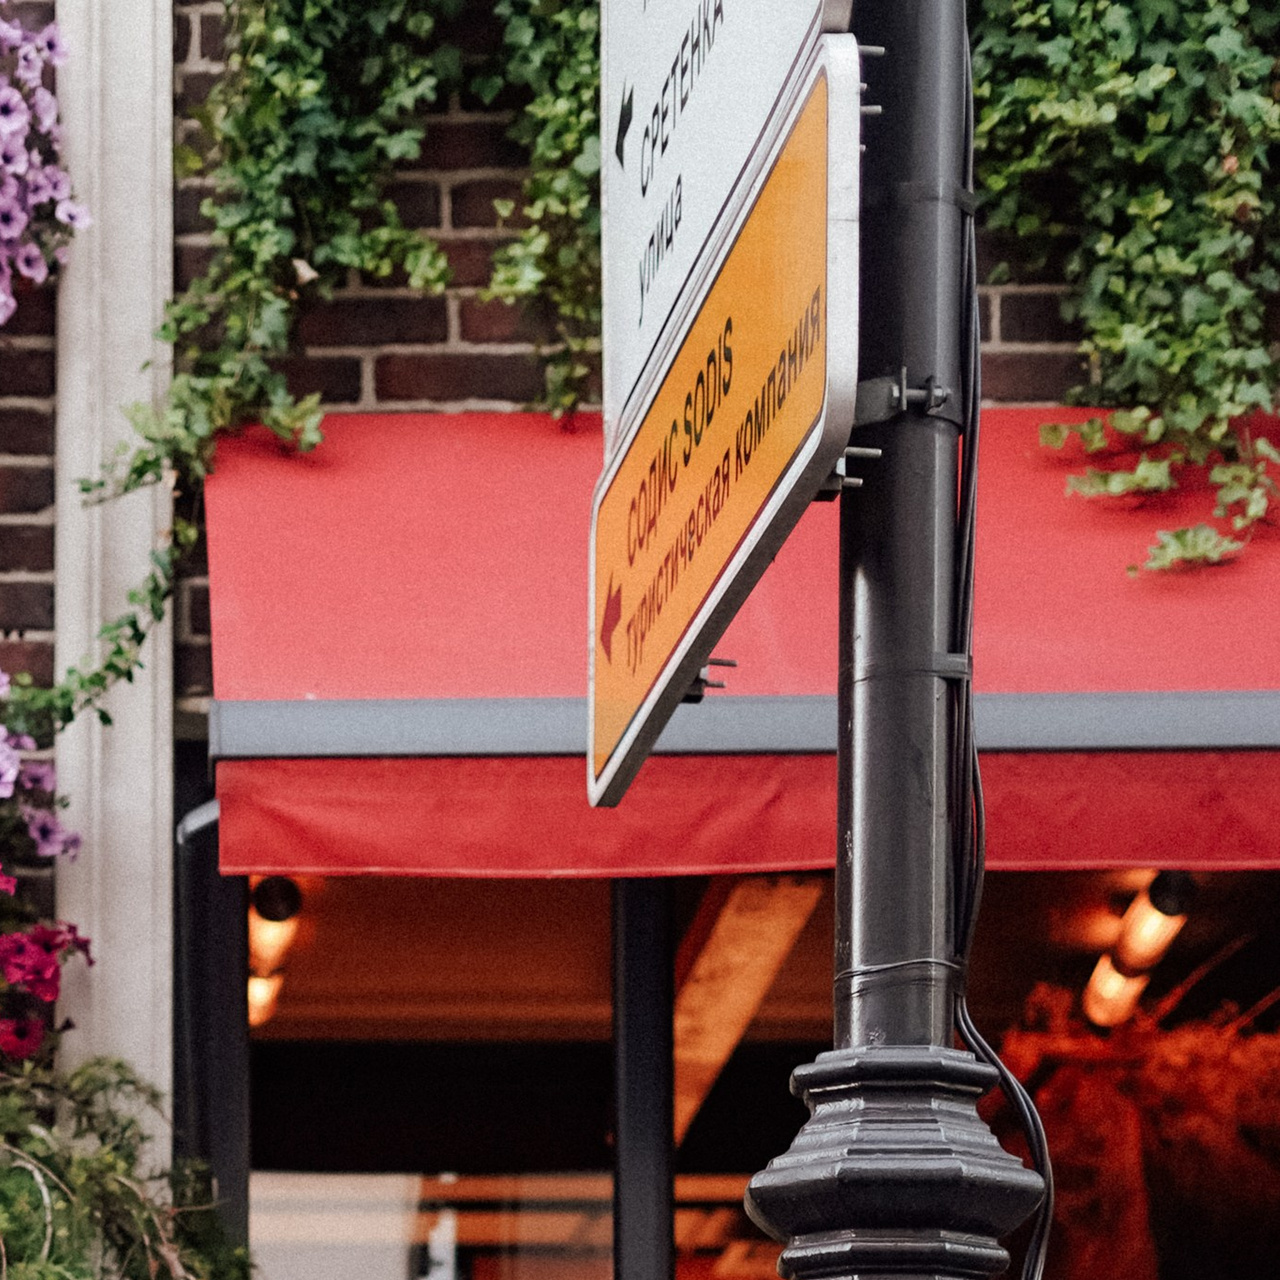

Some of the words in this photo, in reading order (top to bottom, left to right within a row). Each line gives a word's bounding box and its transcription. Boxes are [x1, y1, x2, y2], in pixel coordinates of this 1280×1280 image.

[626, 418, 680, 568] СОДИС
[682, 316, 734, 467] SODIS
[626, 446, 731, 677] туристическая
[735, 284, 821, 473] компания
